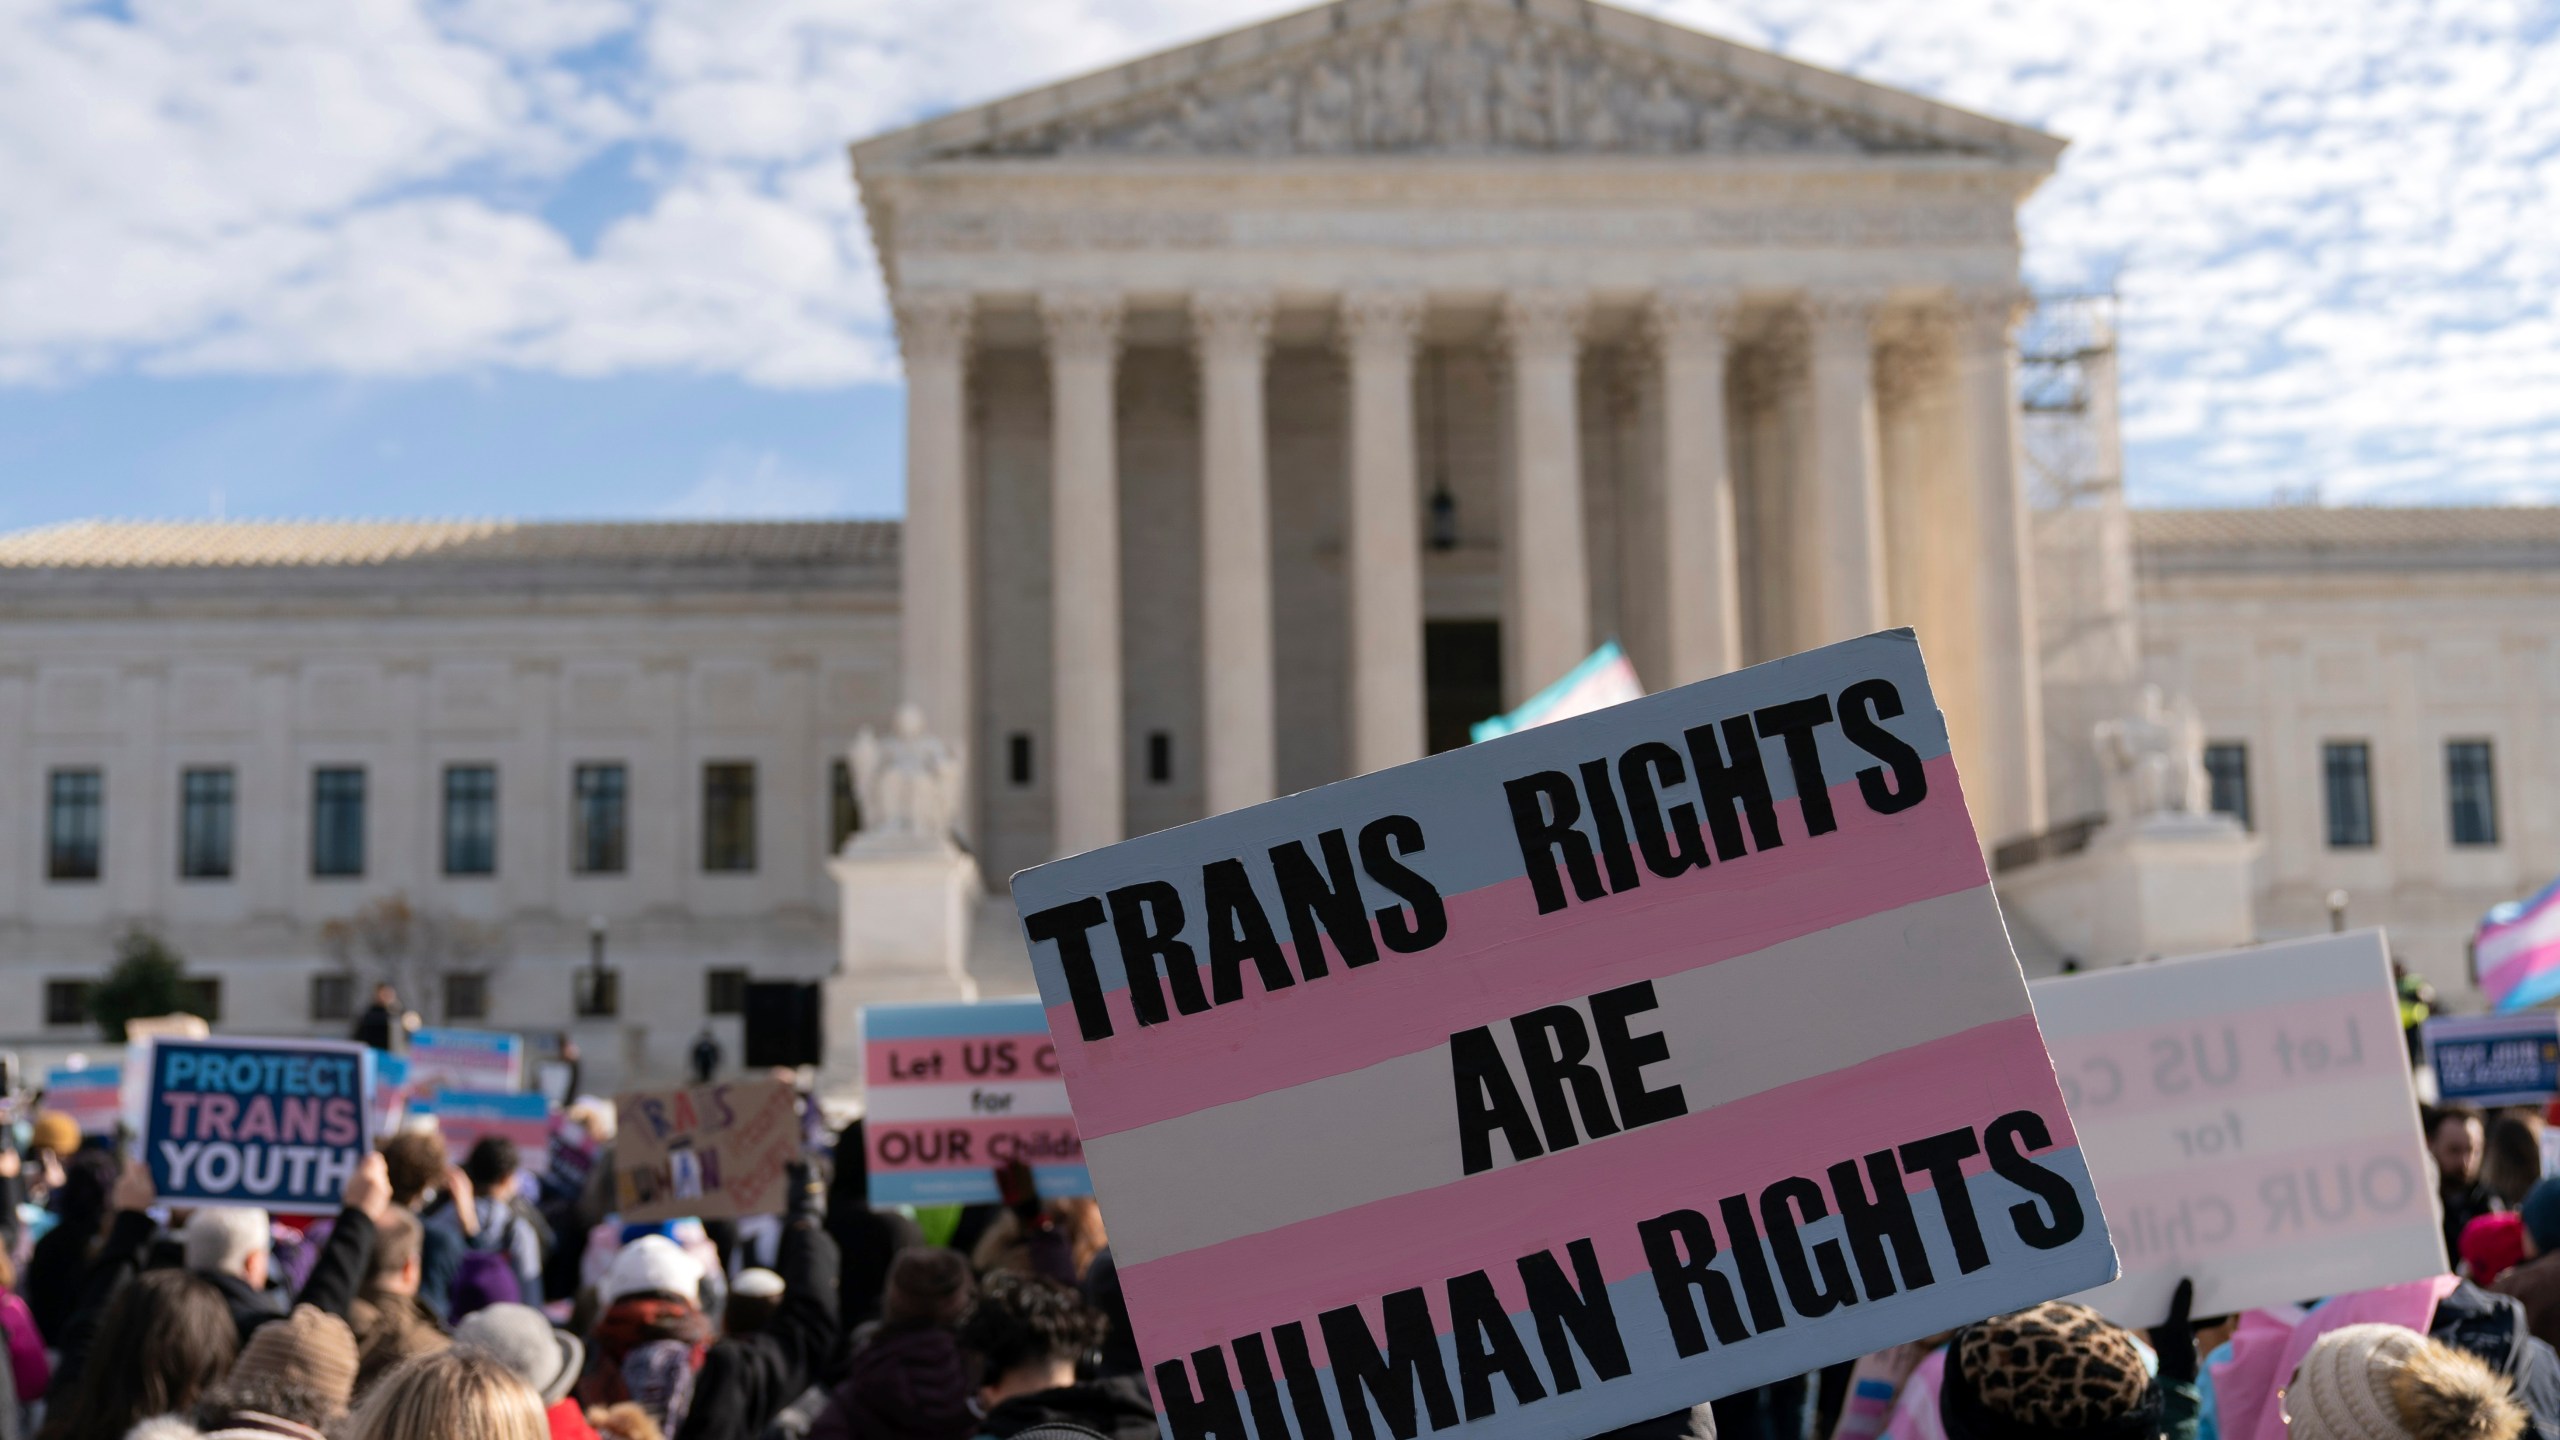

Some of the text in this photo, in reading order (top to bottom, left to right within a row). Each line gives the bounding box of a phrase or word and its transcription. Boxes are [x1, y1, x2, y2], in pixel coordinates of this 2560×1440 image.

[1024, 678, 1928, 1042] TRANS RIGHTS
[164, 1051, 355, 1097] PROTECT
[888, 1050, 943, 1080] Let
[962, 1041, 1018, 1077] US
[1450, 979, 1688, 1176] ARE
[161, 1090, 359, 1146] TRANS
[970, 1088, 1014, 1113] for
[157, 1138, 359, 1197] YOUTH
[878, 1130, 972, 1165] OUR
[1154, 1110, 2085, 1440] HUMAN RIGHTS
